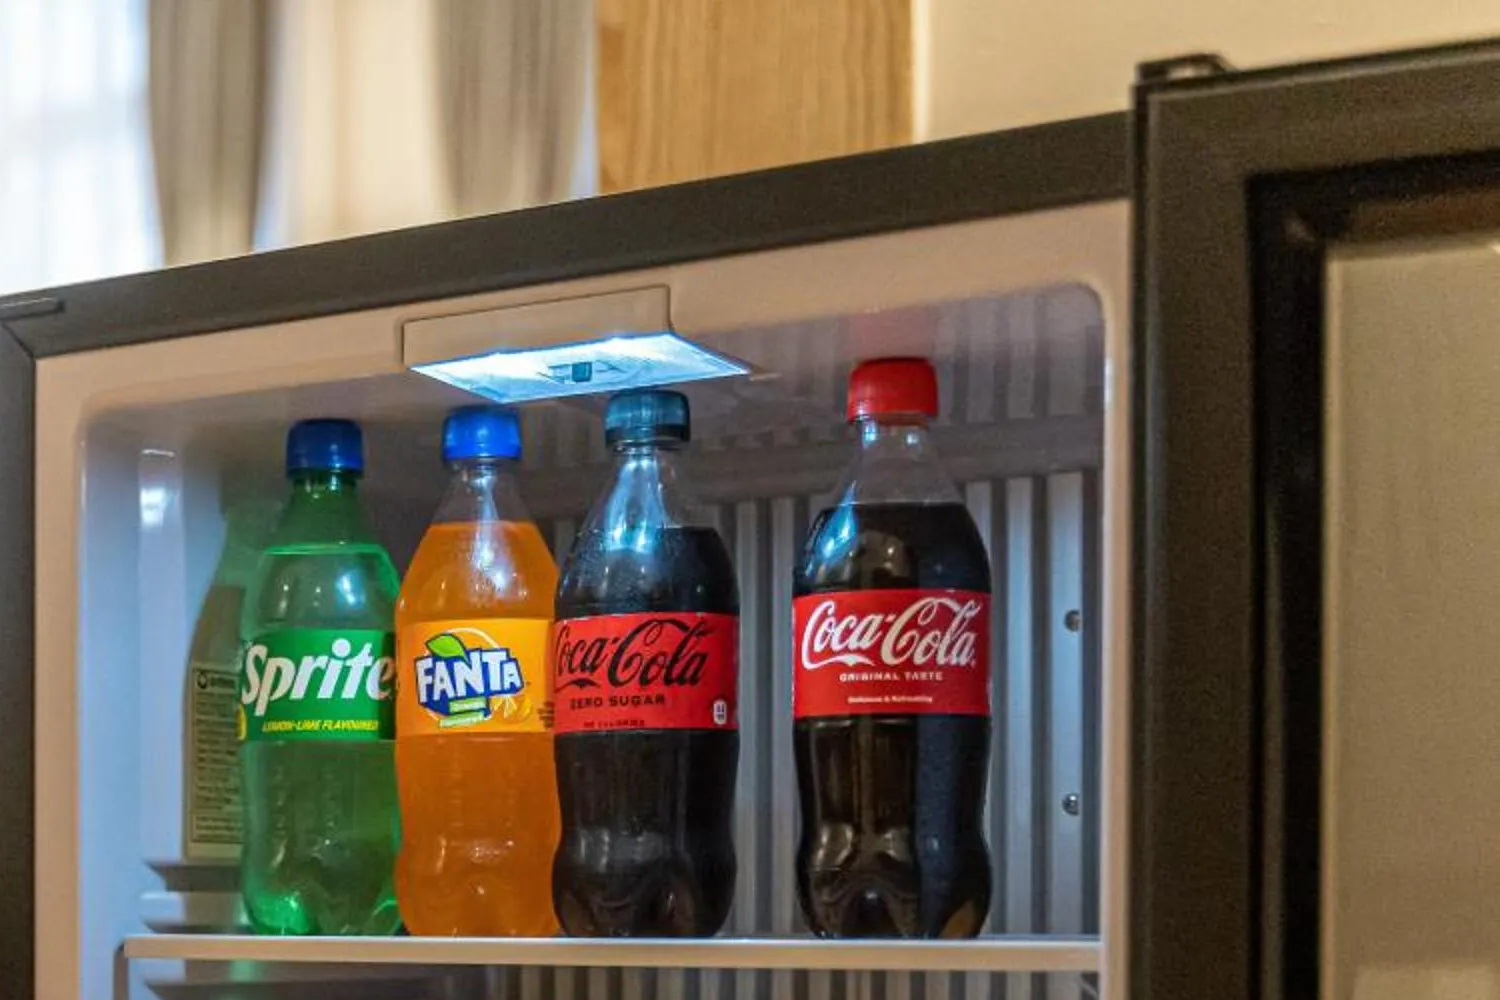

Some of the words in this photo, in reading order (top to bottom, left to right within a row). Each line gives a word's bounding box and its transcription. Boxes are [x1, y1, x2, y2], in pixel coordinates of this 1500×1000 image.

[554, 617, 717, 688] Coca-Cola
[801, 596, 983, 671] Coca-Cola
[241, 637, 396, 717] Sprite
[415, 649, 522, 704] FANTA
[569, 696, 604, 710] ZERO
[608, 693, 666, 708] SUGAR
[839, 671, 900, 683] ORIGINAL
[903, 671, 944, 682] TASTE
